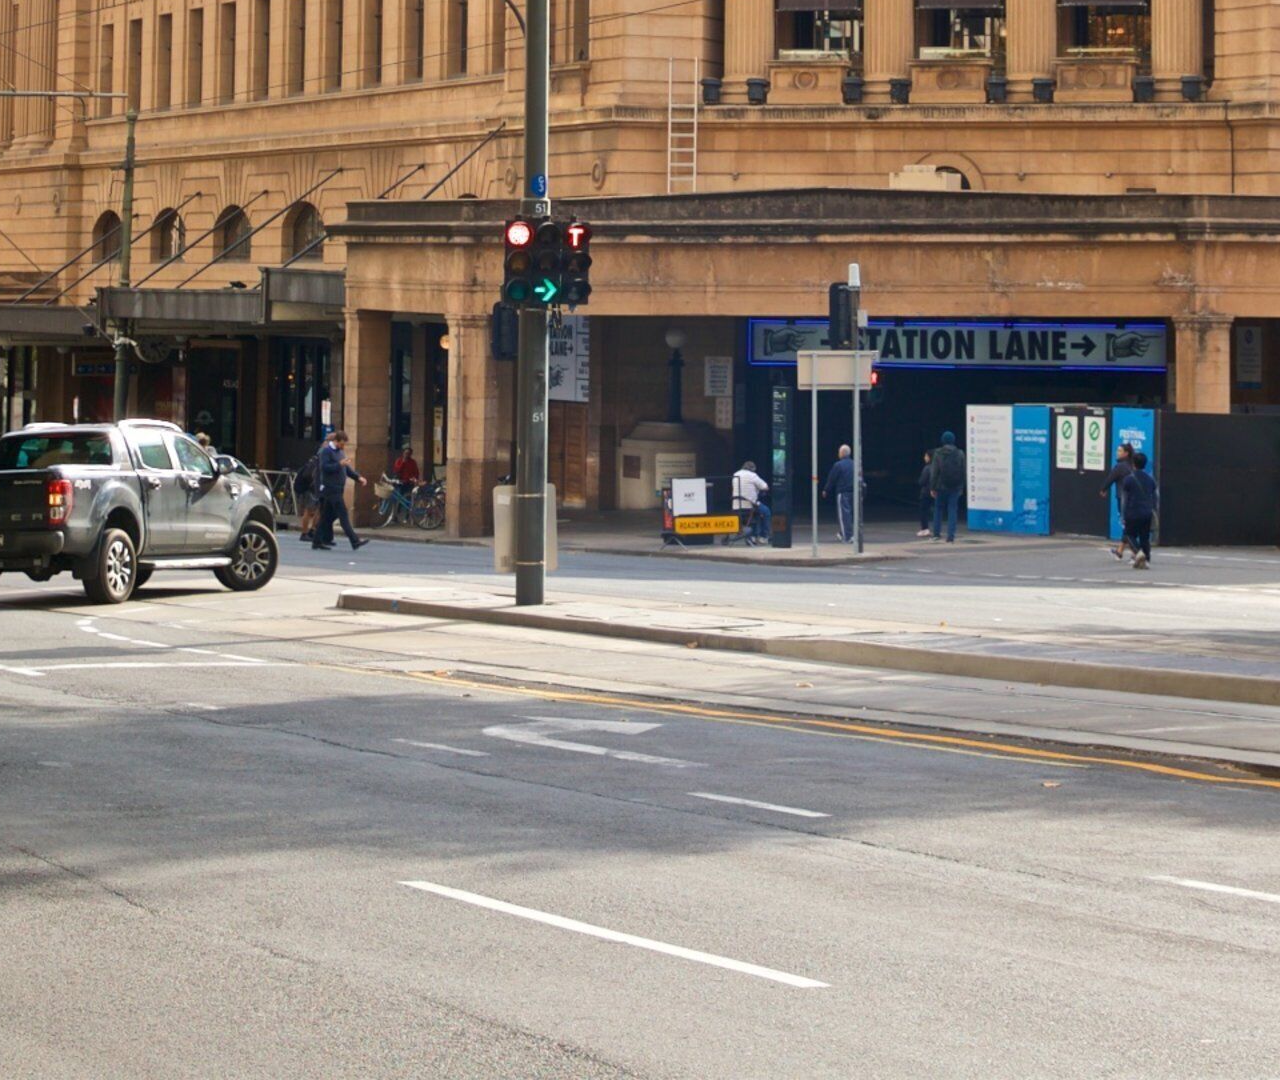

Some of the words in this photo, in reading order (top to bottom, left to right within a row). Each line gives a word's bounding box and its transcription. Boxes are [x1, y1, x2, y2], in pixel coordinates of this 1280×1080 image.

[535, 202, 547, 214] 51
[857, 328, 976, 361] STATION
[989, 329, 1068, 361] LANE
[679, 521, 712, 529] ROADWORK
[714, 519, 735, 528] AHEAD
